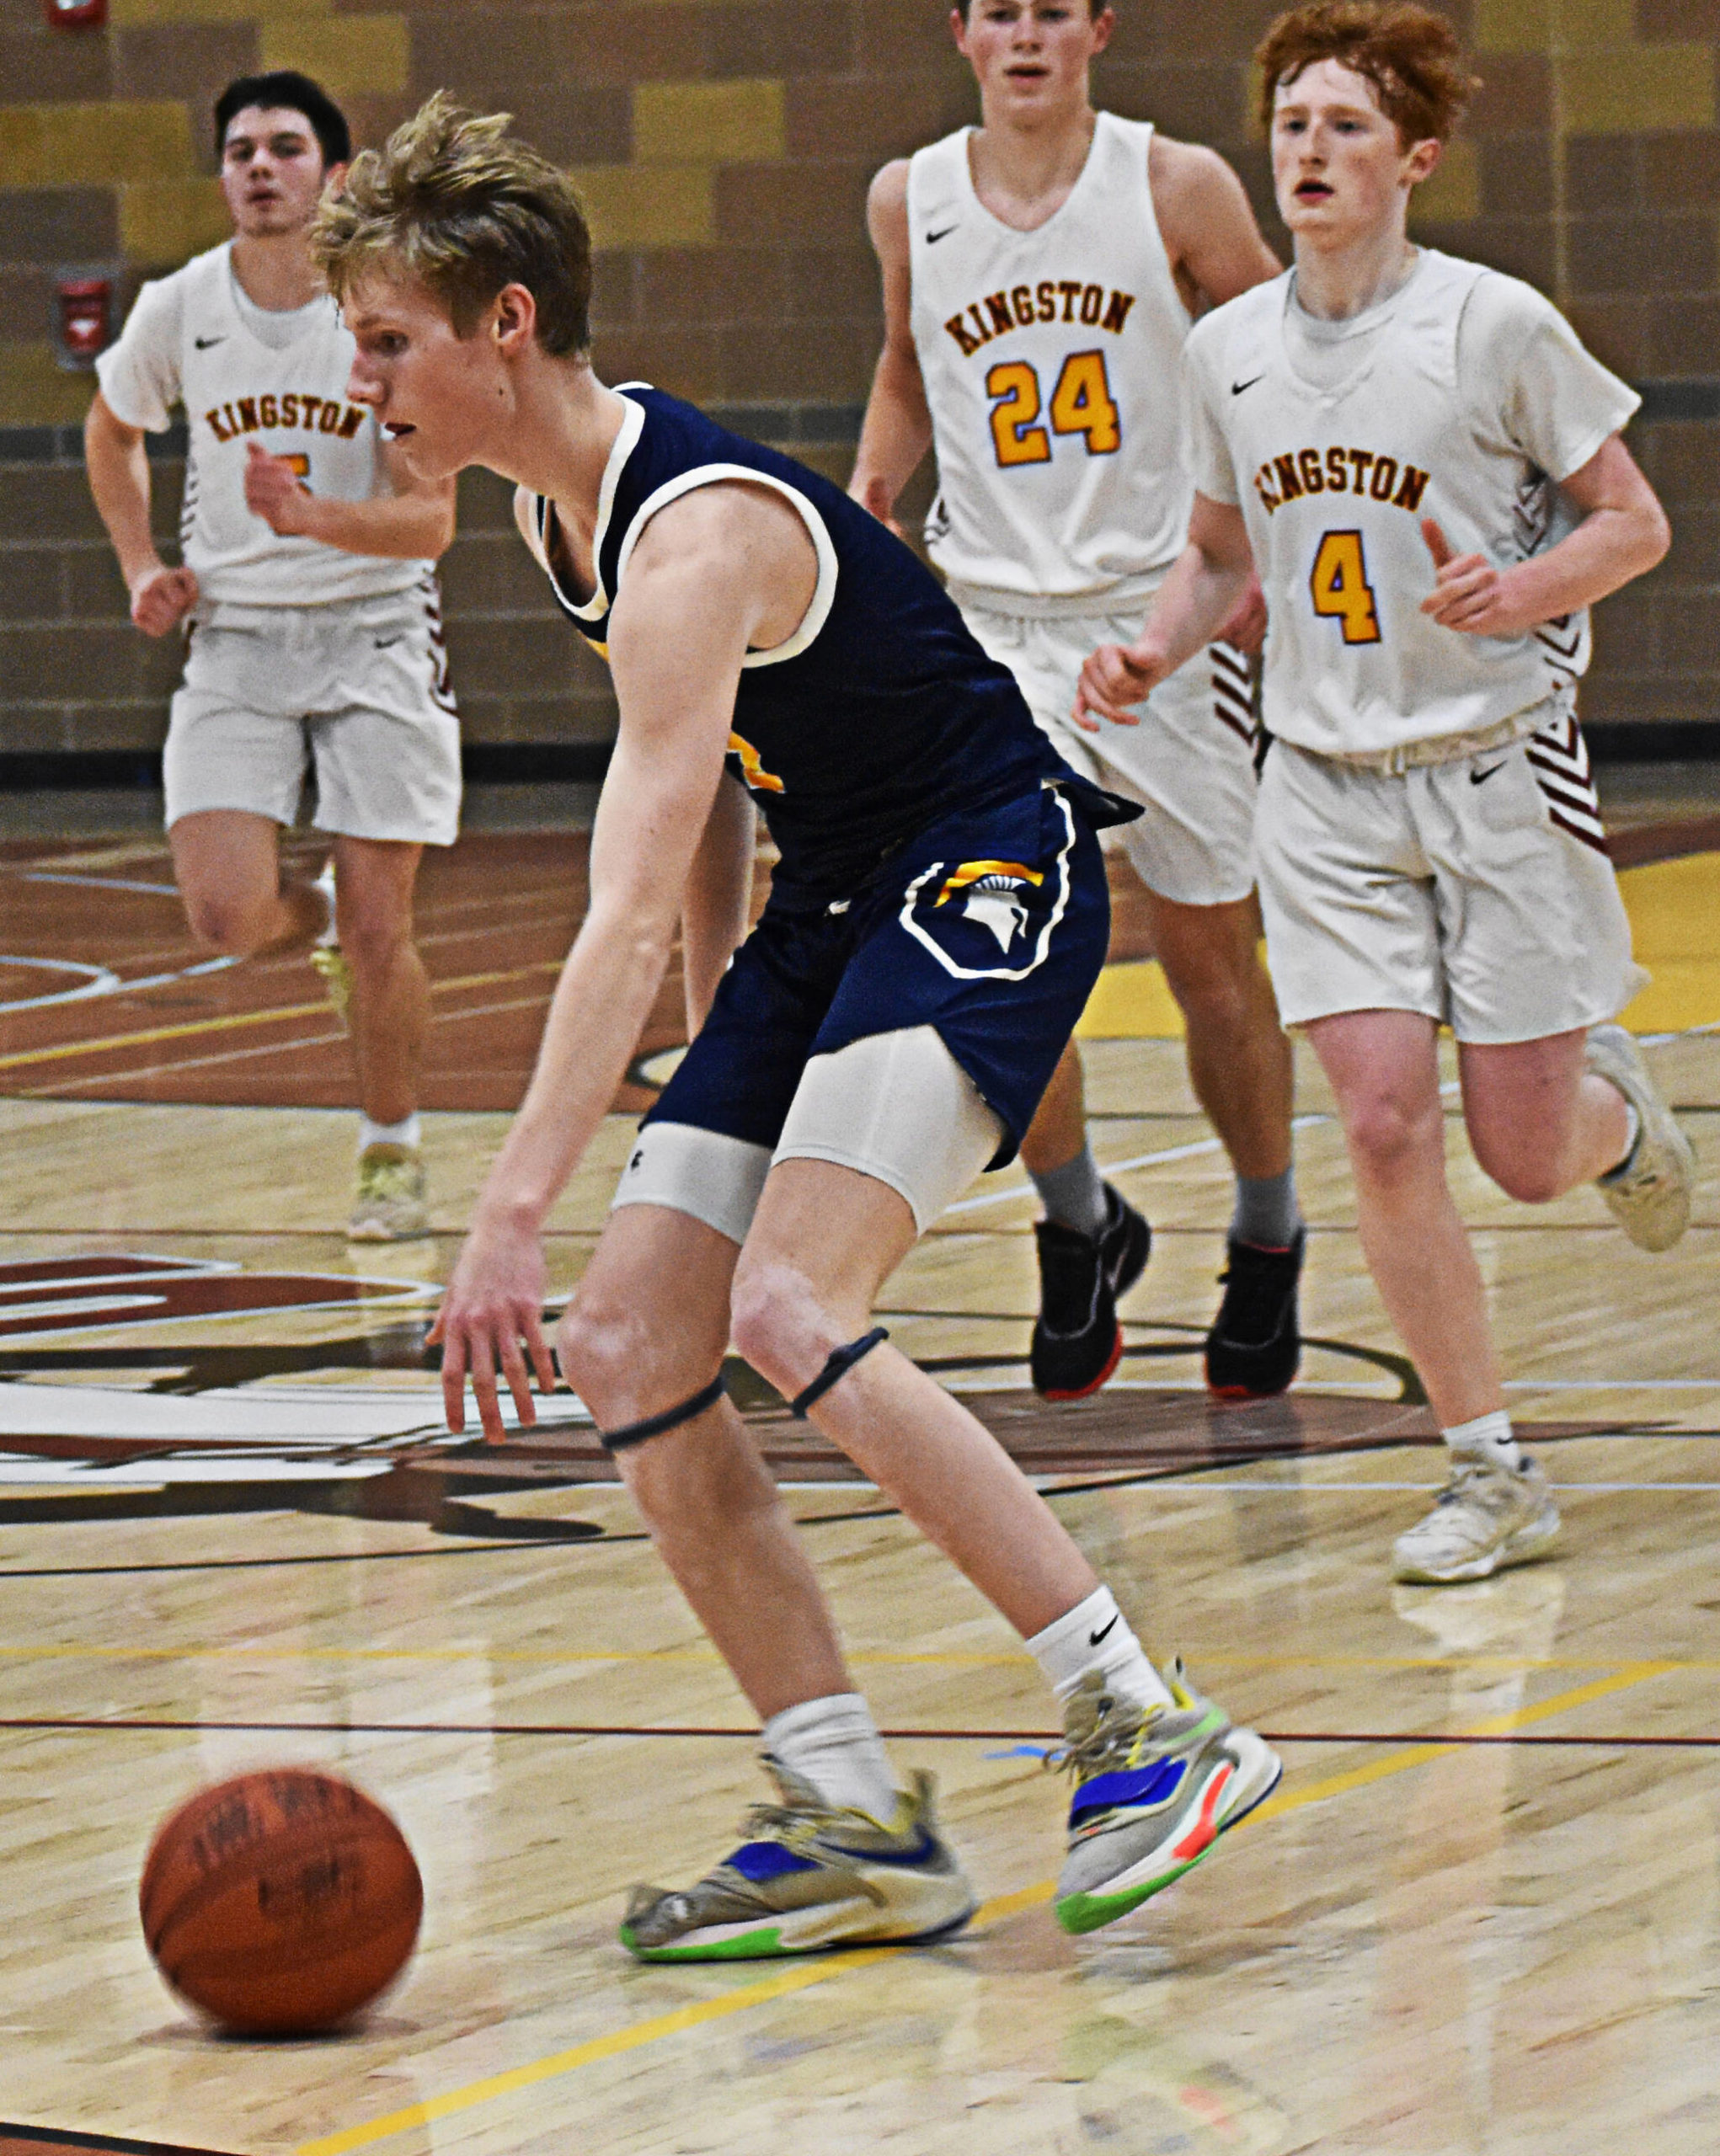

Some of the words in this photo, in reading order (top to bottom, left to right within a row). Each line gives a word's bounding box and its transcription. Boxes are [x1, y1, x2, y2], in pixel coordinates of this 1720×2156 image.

[943, 280, 1136, 357] KINGSTON
[205, 392, 366, 443] KINGSTON
[985, 348, 1122, 469] 24
[1310, 529, 1382, 645] 4
